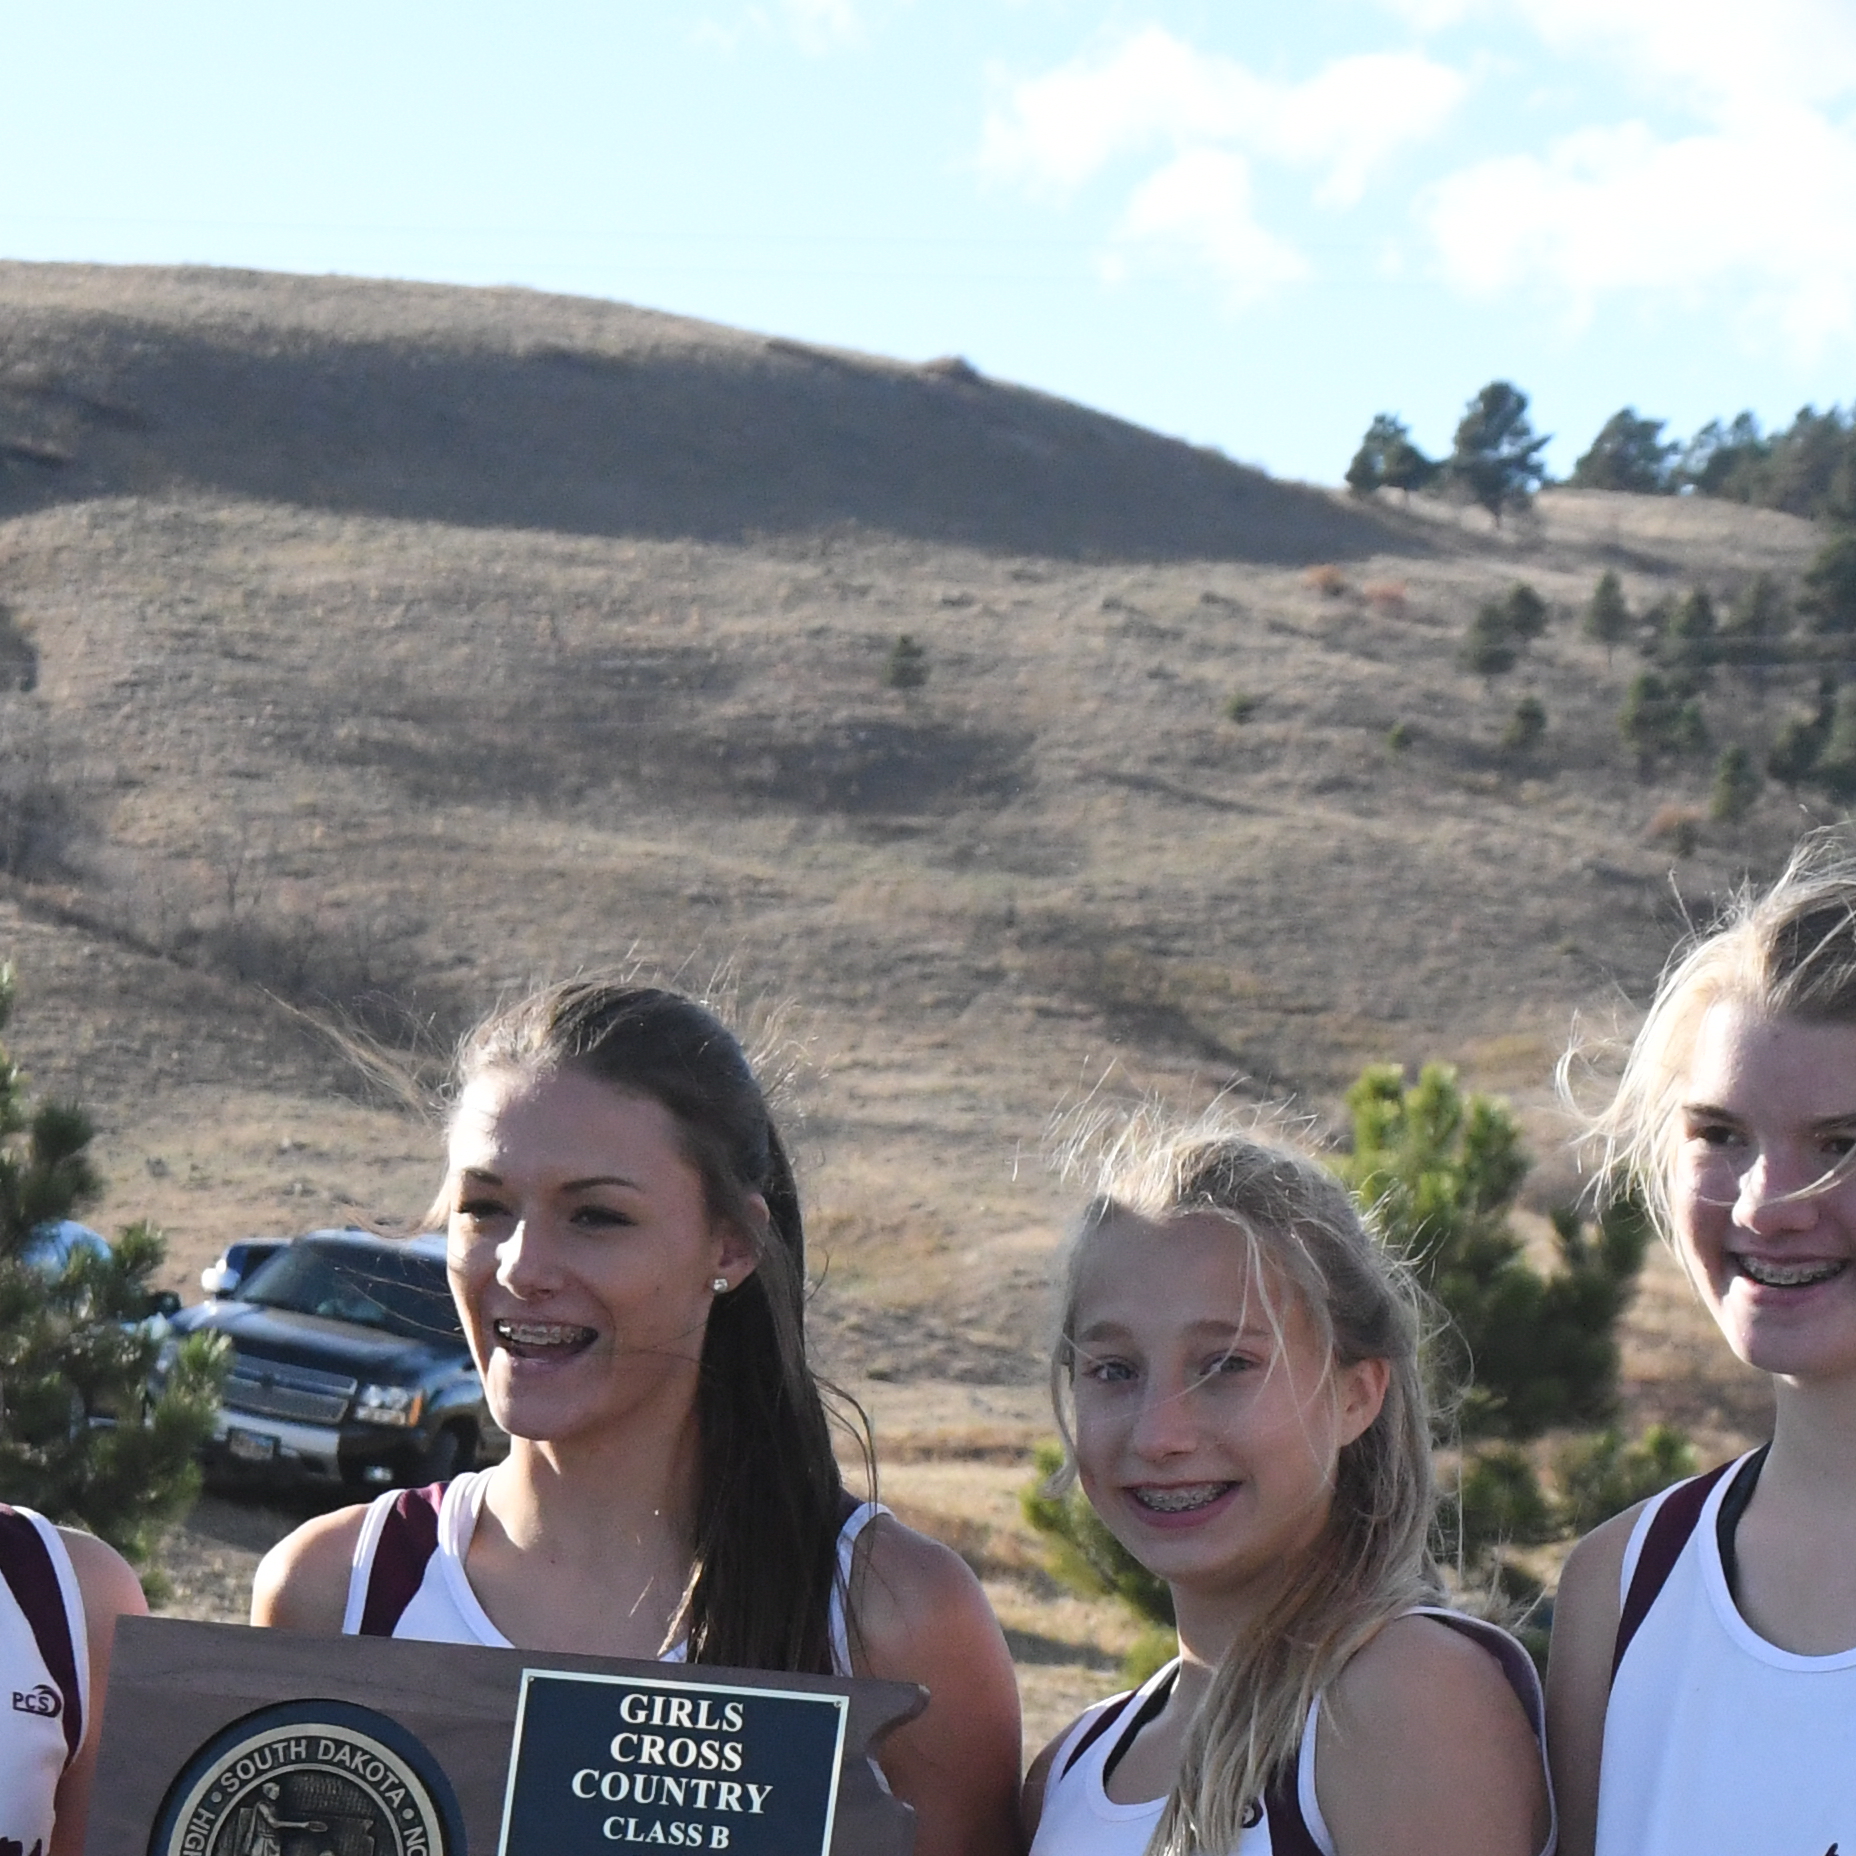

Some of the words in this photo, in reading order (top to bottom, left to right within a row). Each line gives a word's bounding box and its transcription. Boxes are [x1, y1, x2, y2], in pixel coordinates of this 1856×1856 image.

[12, 1691, 50, 1713] PCS
[619, 1693, 744, 1733] GIRLS
[610, 1732, 743, 1772] CROSS
[220, 1739, 307, 1793] SOUTH
[317, 1739, 406, 1810] DAKOTA
[571, 1768, 773, 1814] COUNTRY
[602, 1816, 703, 1847] CLASS
[709, 1825, 731, 1849] B
